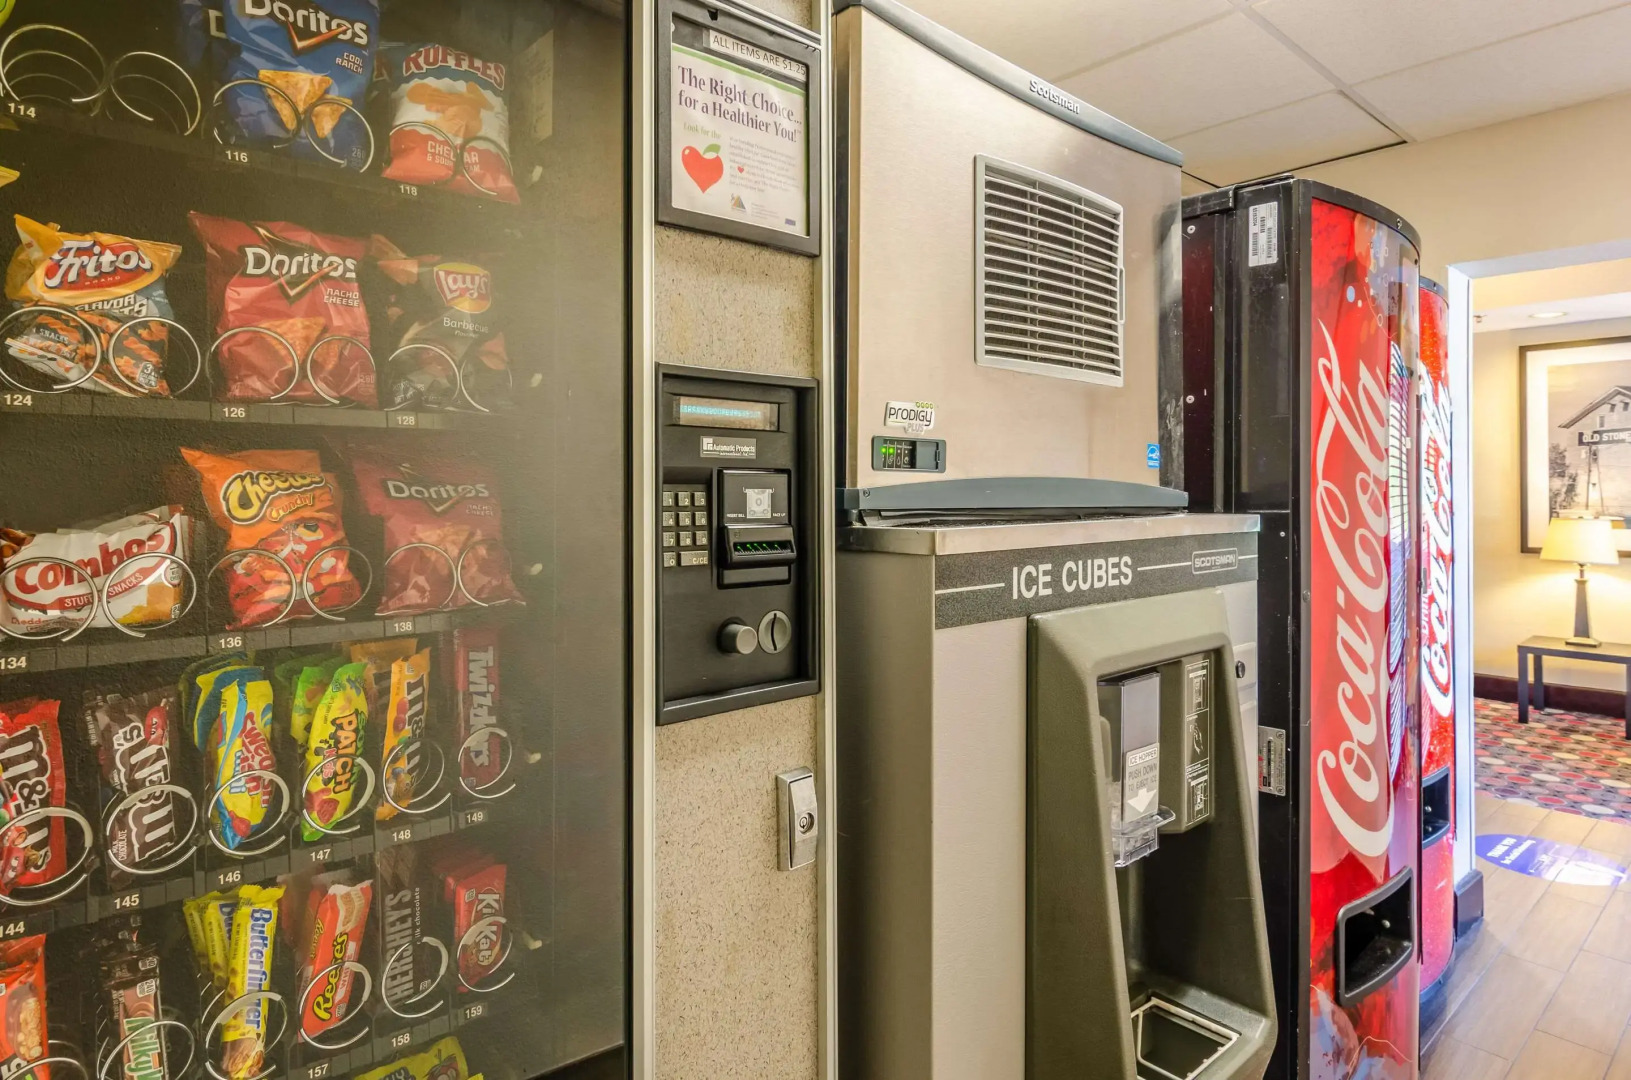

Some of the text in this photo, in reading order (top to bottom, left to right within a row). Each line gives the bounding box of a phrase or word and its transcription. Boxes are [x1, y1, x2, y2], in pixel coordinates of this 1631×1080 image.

[244, 0, 369, 46] Doritos
[342, 51, 364, 66] COOL
[712, 34, 807, 76] ALL ITEMS ARE $1.25
[335, 57, 364, 75] RANCH
[403, 44, 506, 91] RUFFLES
[678, 65, 706, 92] The
[709, 77, 748, 106] Right
[1029, 79, 1080, 115] Scotsman
[8, 102, 36, 118] 114
[678, 89, 699, 111] for
[701, 101, 709, 115] a
[712, 100, 771, 134] Healthier
[683, 121, 700, 134] Look
[225, 150, 248, 163] 116
[399, 185, 418, 197] 118
[44, 239, 152, 289] Fritos
[245, 246, 358, 278] Doritos
[323, 295, 360, 307] CHEESE
[326, 288, 360, 299] NACHO
[443, 316, 489, 333] Barbecue
[4, 393, 33, 406] 124
[222, 406, 246, 419] 126
[396, 415, 415, 425] 128
[907, 422, 924, 432] PLUS
[1582, 433, 1600, 443] OLD
[713, 443, 756, 452] Automatic Products
[223, 470, 326, 523] Cheetos
[386, 480, 490, 499] Doritos
[266, 493, 314, 522] Crunchy
[1194, 554, 1236, 568] SCOTSMAN
[108, 572, 144, 596] SNACKS
[1011, 555, 1133, 600] ICE CUBES
[393, 621, 412, 632] 138
[219, 636, 242, 649] 136
[0, 656, 27, 669] 134
[333, 710, 358, 795] PATCH
[1129, 748, 1157, 766] ICE HOPPER
[1128, 763, 1158, 780] PUSH DOWN
[1128, 774, 1158, 792] TO EJECT ICE
[466, 811, 484, 823] 149
[392, 829, 411, 842] 148
[118, 829, 128, 861] CHOCOLATE
[310, 848, 331, 861] 147
[218, 870, 241, 884] 146
[114, 895, 139, 909] 145
[0, 921, 25, 938] 144
[384, 888, 415, 1007] HERSHEY'S
[475, 925, 498, 963] Kat
[145, 980, 155, 994] 240
[465, 1005, 483, 1018] 159
[391, 1032, 411, 1047] 158
[308, 1063, 329, 1079] 157
